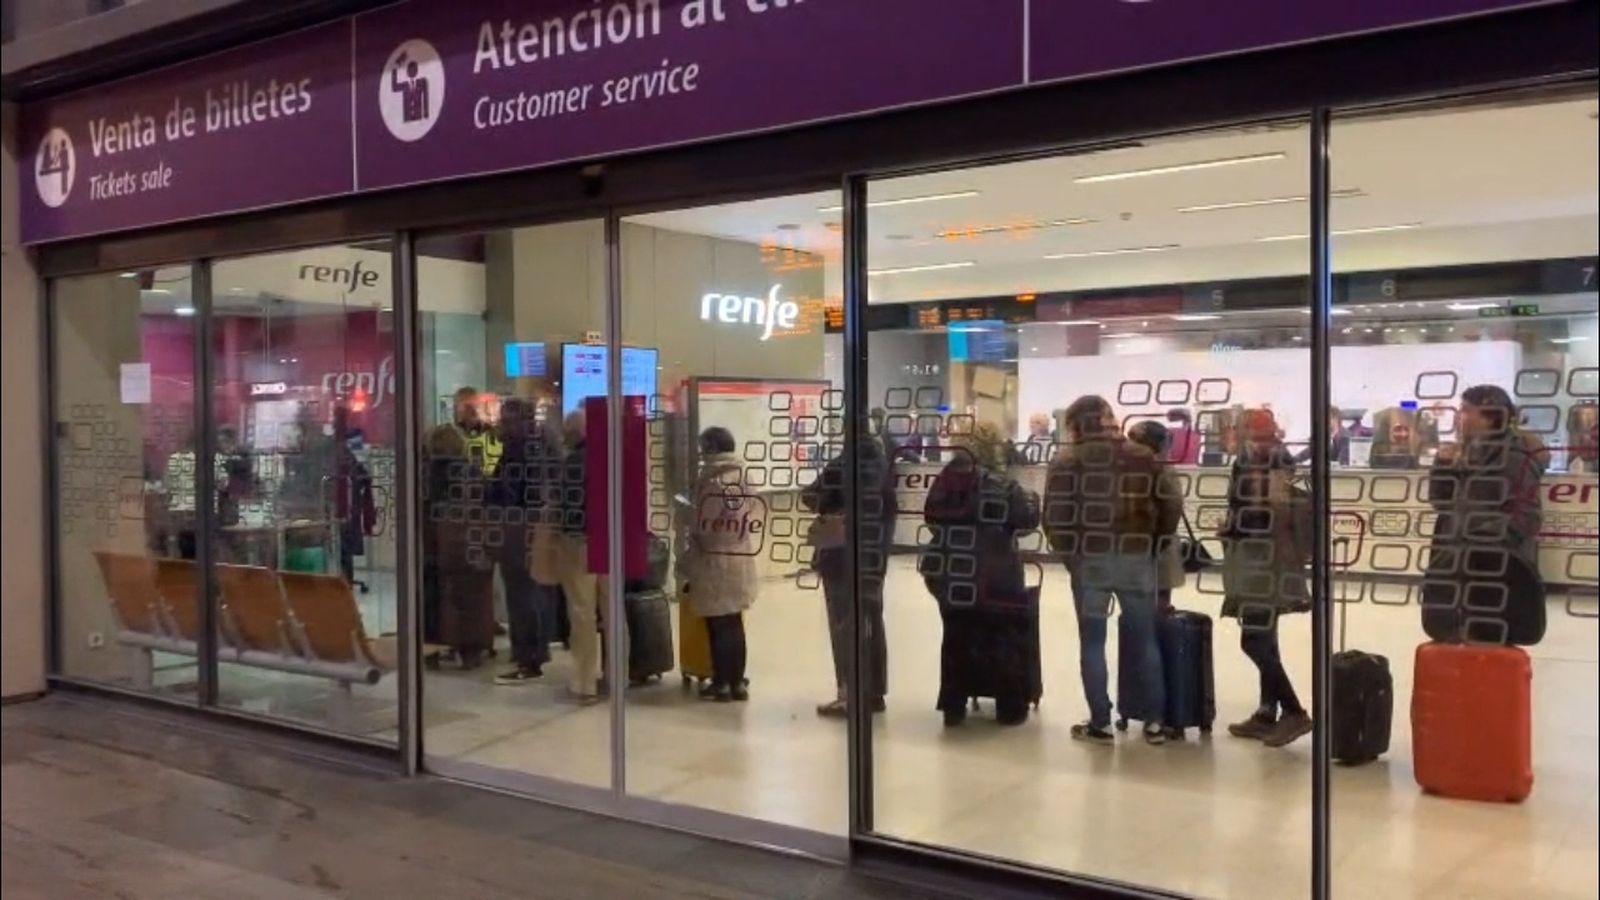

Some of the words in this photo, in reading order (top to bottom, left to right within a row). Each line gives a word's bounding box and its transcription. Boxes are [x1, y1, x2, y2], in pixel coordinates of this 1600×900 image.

[473, 82, 594, 129] Customer
[601, 59, 700, 107] service
[88, 113, 156, 158] Venta
[165, 97, 196, 142] de
[206, 78, 312, 133] billetes
[89, 171, 137, 200] Tickets
[140, 160, 173, 191] sale
[298, 260, 380, 293] renfe
[1582, 266, 1596, 286] 7
[700, 283, 799, 341] renfe
[320, 356, 396, 409] renf
[701, 510, 763, 541] renfe
